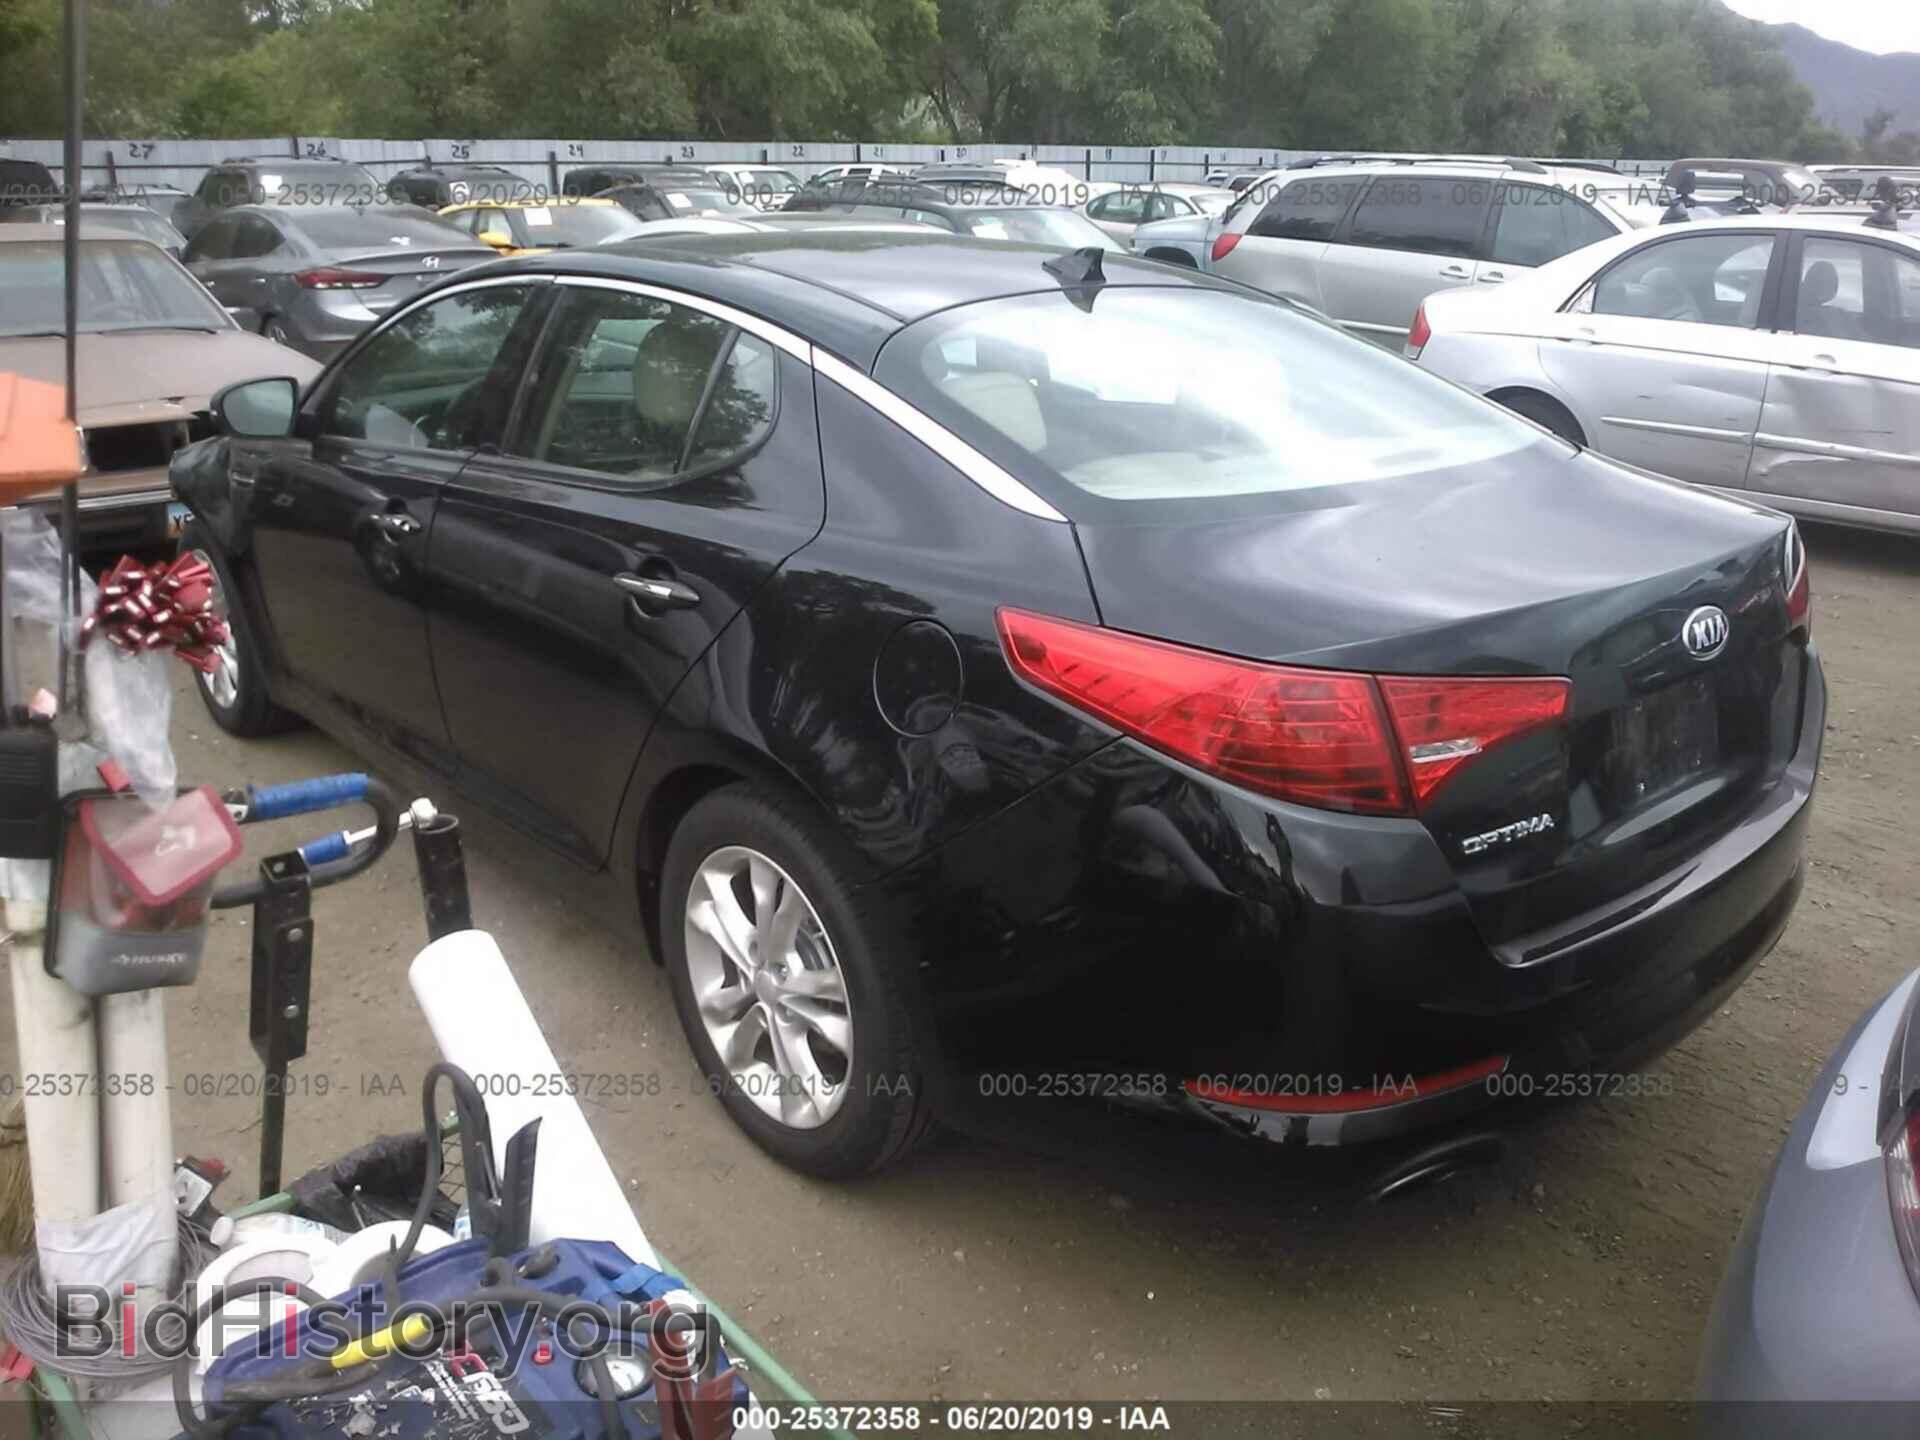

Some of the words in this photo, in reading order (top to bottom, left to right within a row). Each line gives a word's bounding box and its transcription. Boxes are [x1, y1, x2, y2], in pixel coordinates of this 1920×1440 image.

[128, 143, 155, 159] 27
[451, 144, 471, 160] 25
[681, 145, 696, 159] 23
[792, 145, 806, 158] 22
[1691, 613, 1727, 650] KIA
[1461, 813, 1554, 854] OPTIMA
